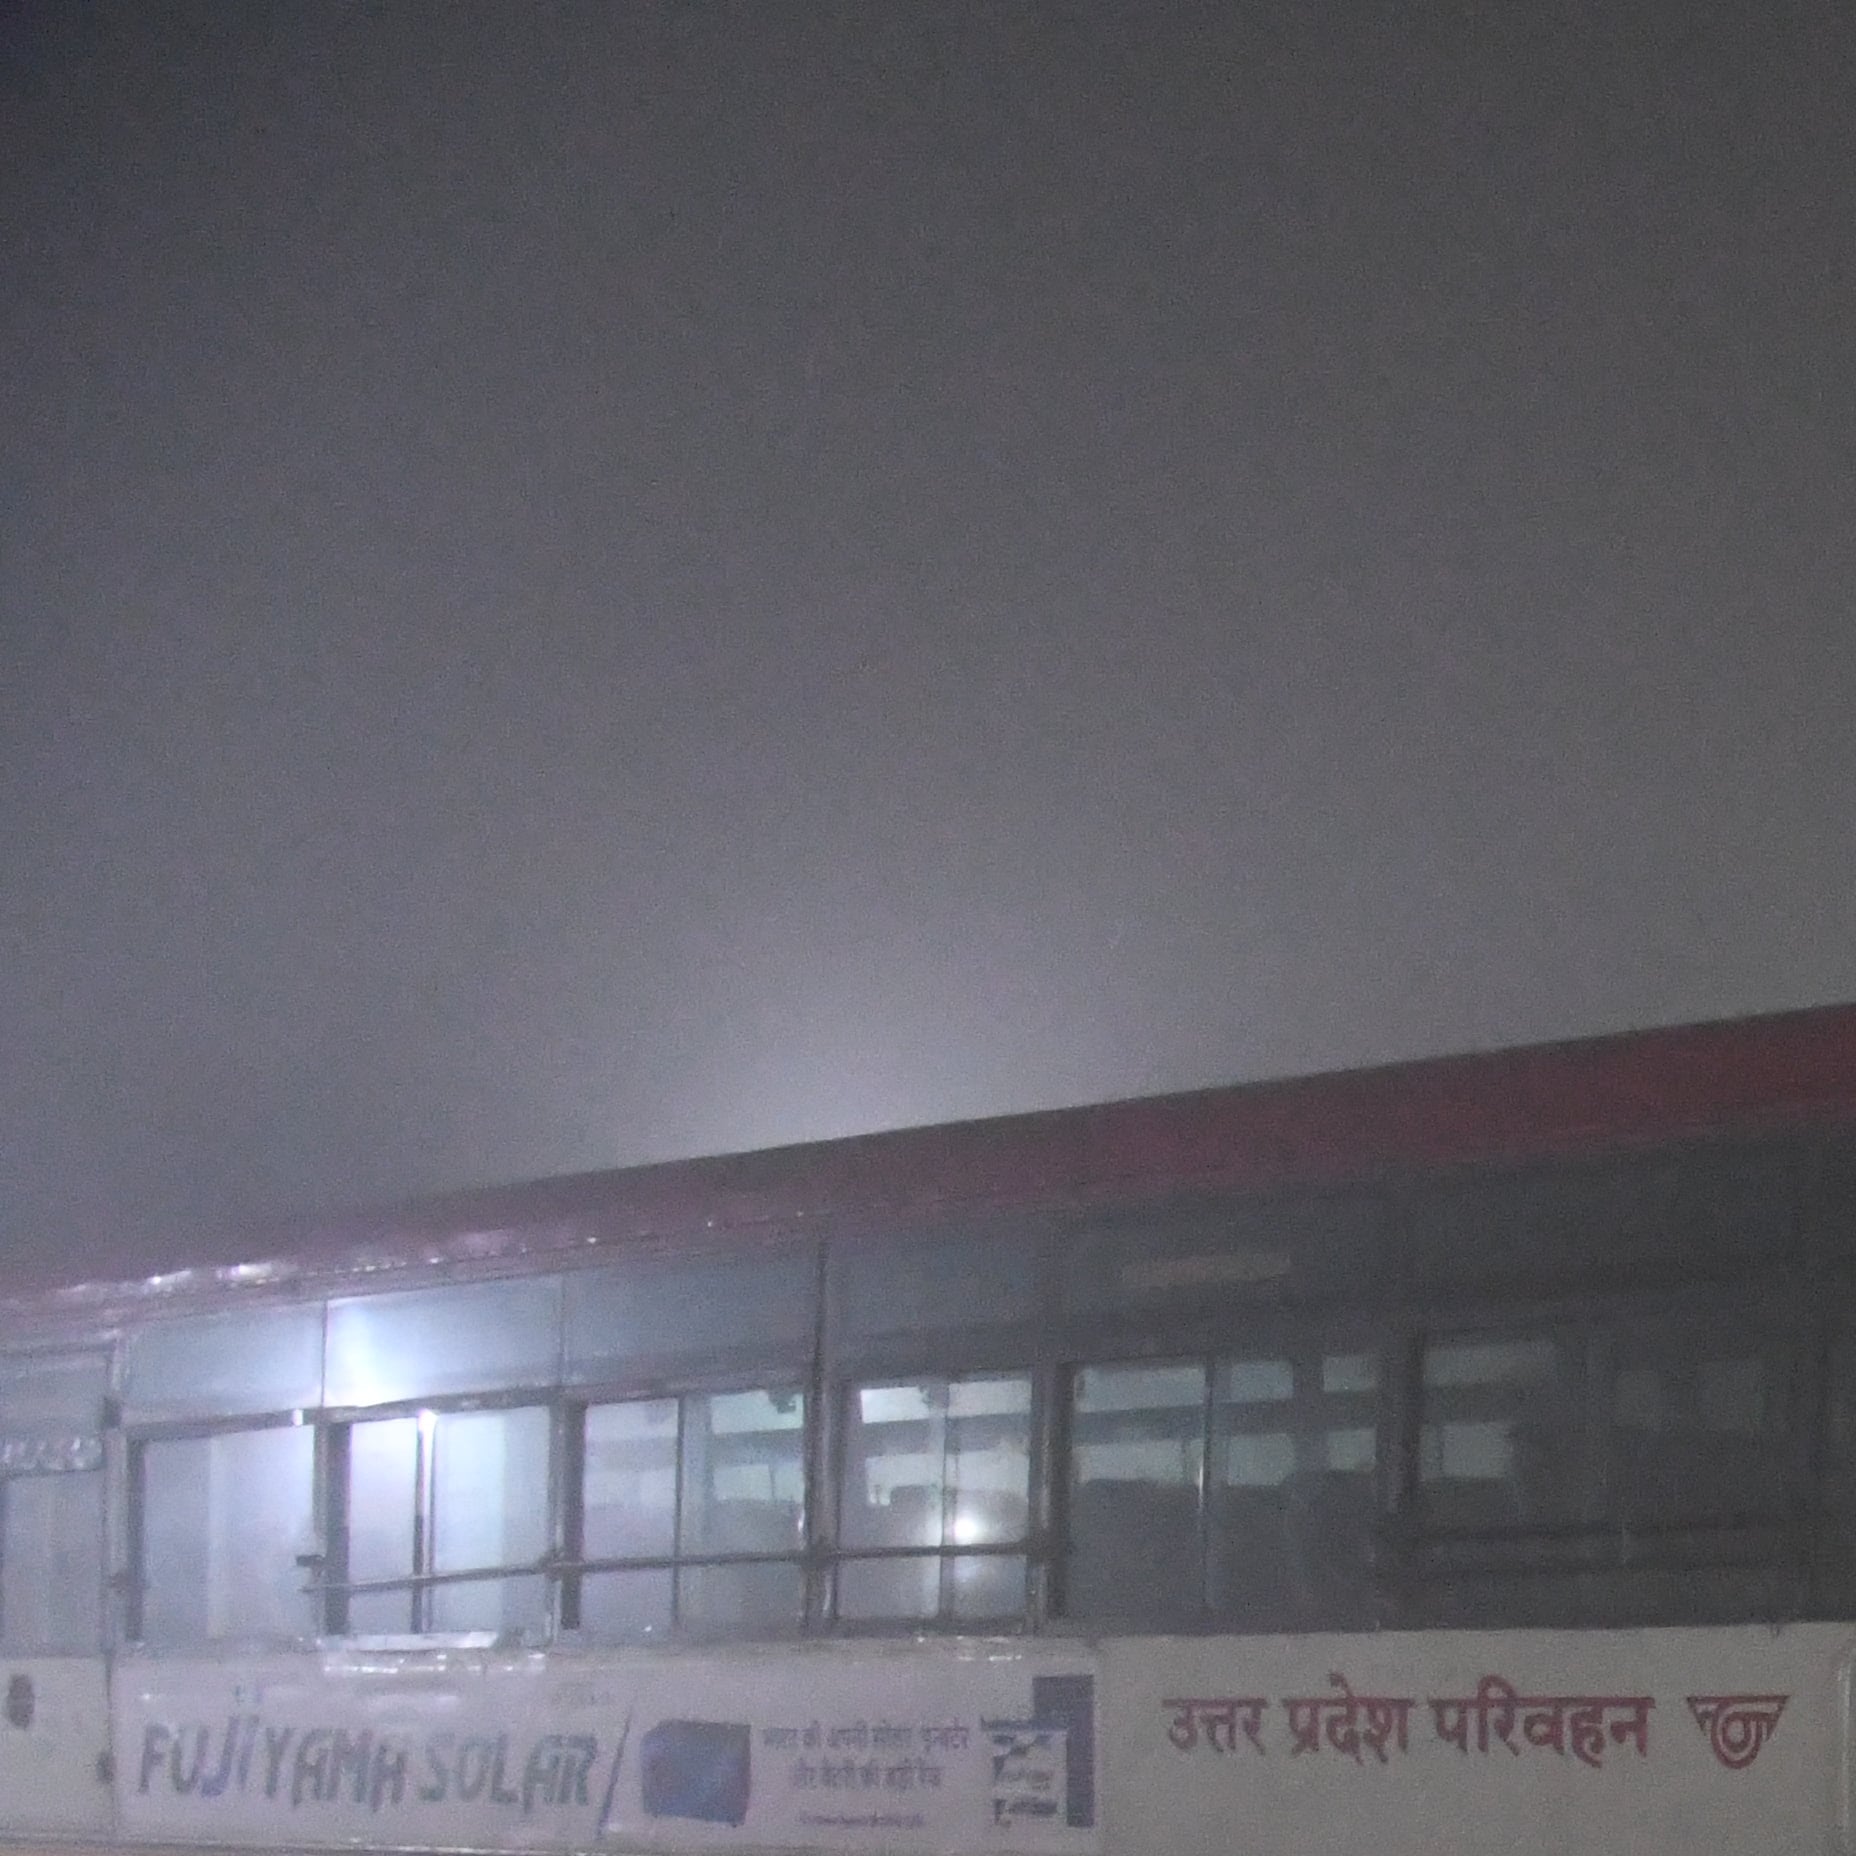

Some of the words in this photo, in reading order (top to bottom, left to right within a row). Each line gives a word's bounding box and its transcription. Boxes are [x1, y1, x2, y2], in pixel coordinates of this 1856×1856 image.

[137, 1713, 409, 1814] FUJIYAMA
[417, 1731, 601, 1814] SOLAR
[1161, 1697, 1269, 1754] उत्तर
[1282, 1671, 1416, 1766] प्रदेश
[1428, 1674, 1657, 1767] परिवहन
